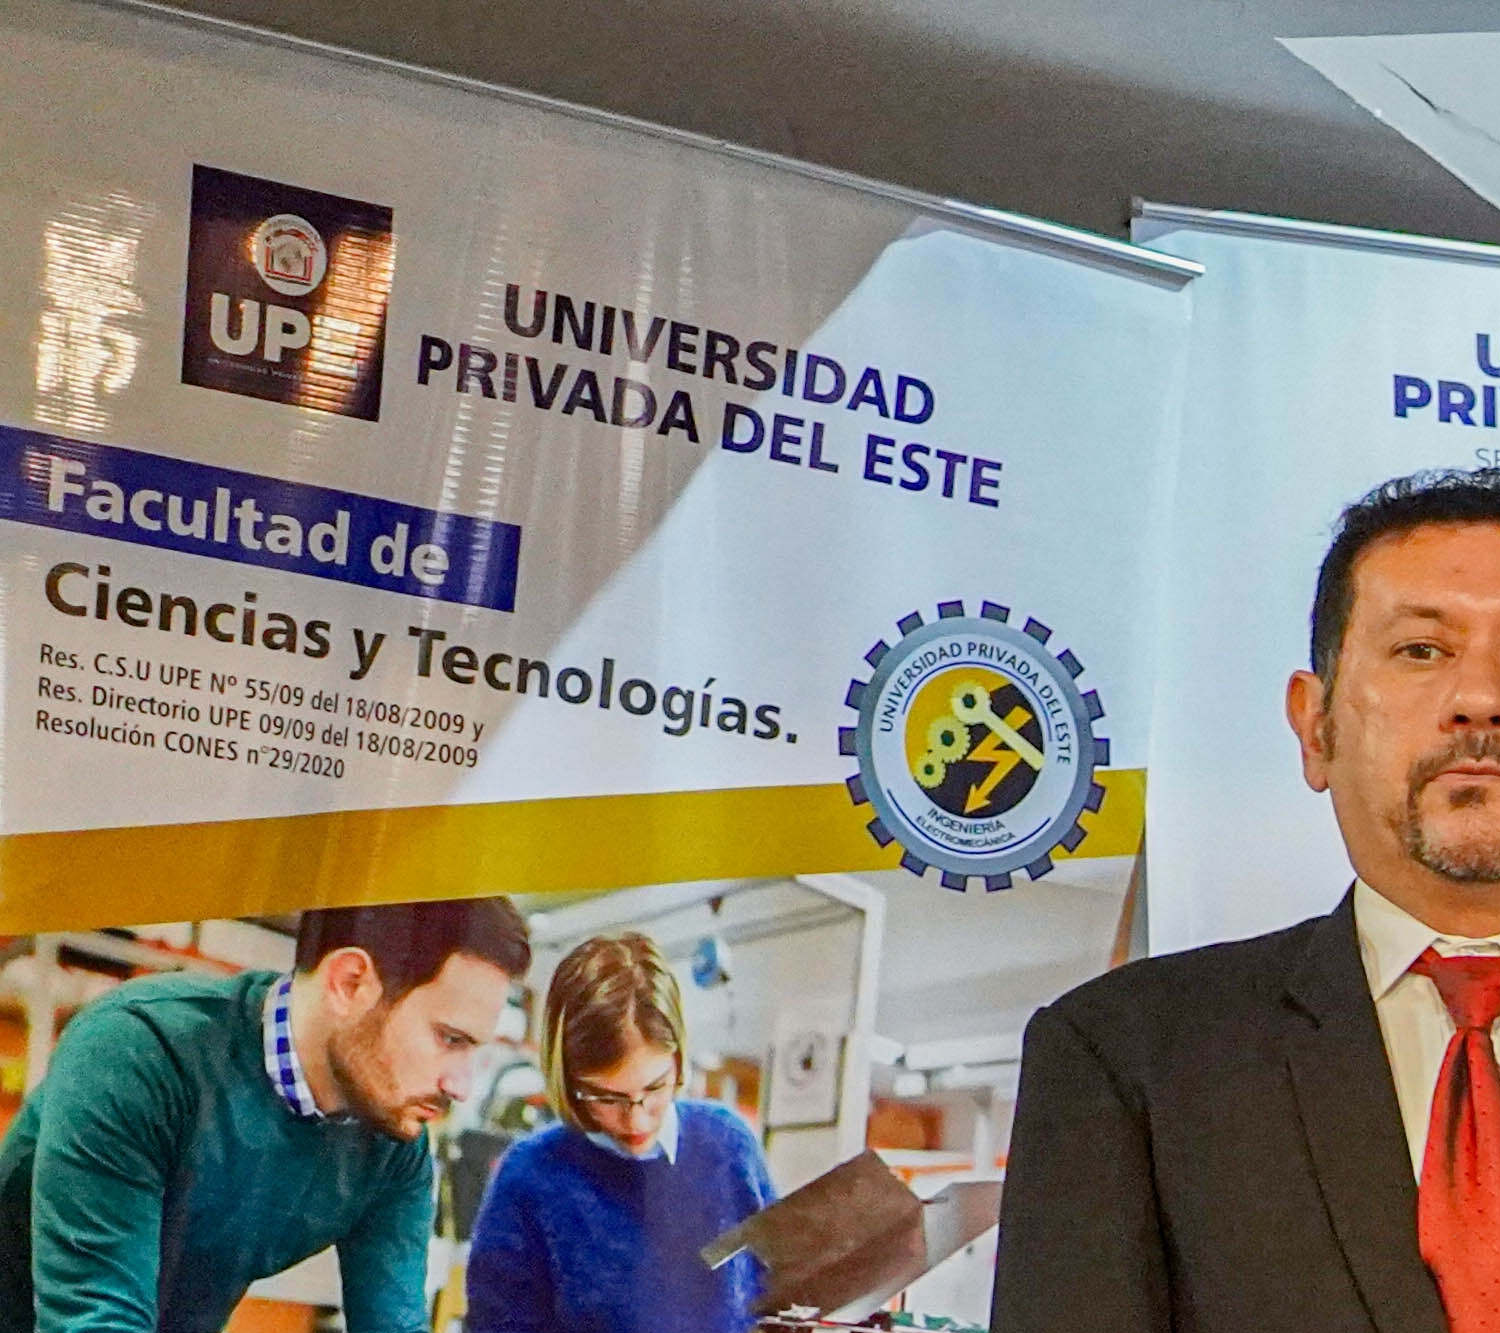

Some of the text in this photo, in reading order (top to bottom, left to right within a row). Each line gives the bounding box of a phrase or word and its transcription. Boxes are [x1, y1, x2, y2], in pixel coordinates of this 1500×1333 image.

[504, 284, 935, 424] UNIVERSIDAD
[417, 335, 1002, 508] PRIVADA DEL ESTE
[45, 455, 450, 586] Facultad de
[41, 644, 84, 670] Res.
[95, 654, 150, 680] C.S.U
[160, 664, 201, 690] UPE
[246, 680, 304, 708] 55/09
[311, 690, 338, 713] del
[347, 697, 464, 735] 18/08/2009
[473, 720, 484, 742] y
[45, 562, 798, 744] Ciencias y Tecnologías.
[880, 641, 1071, 765] UNIVERSIDAD PRIVADA DEL ESTE
[36, 710, 155, 748] Resolución
[164, 731, 238, 761] CONES
[38, 677, 478, 768] Res. Directorio UPE 09/09 del 18/08/2009
